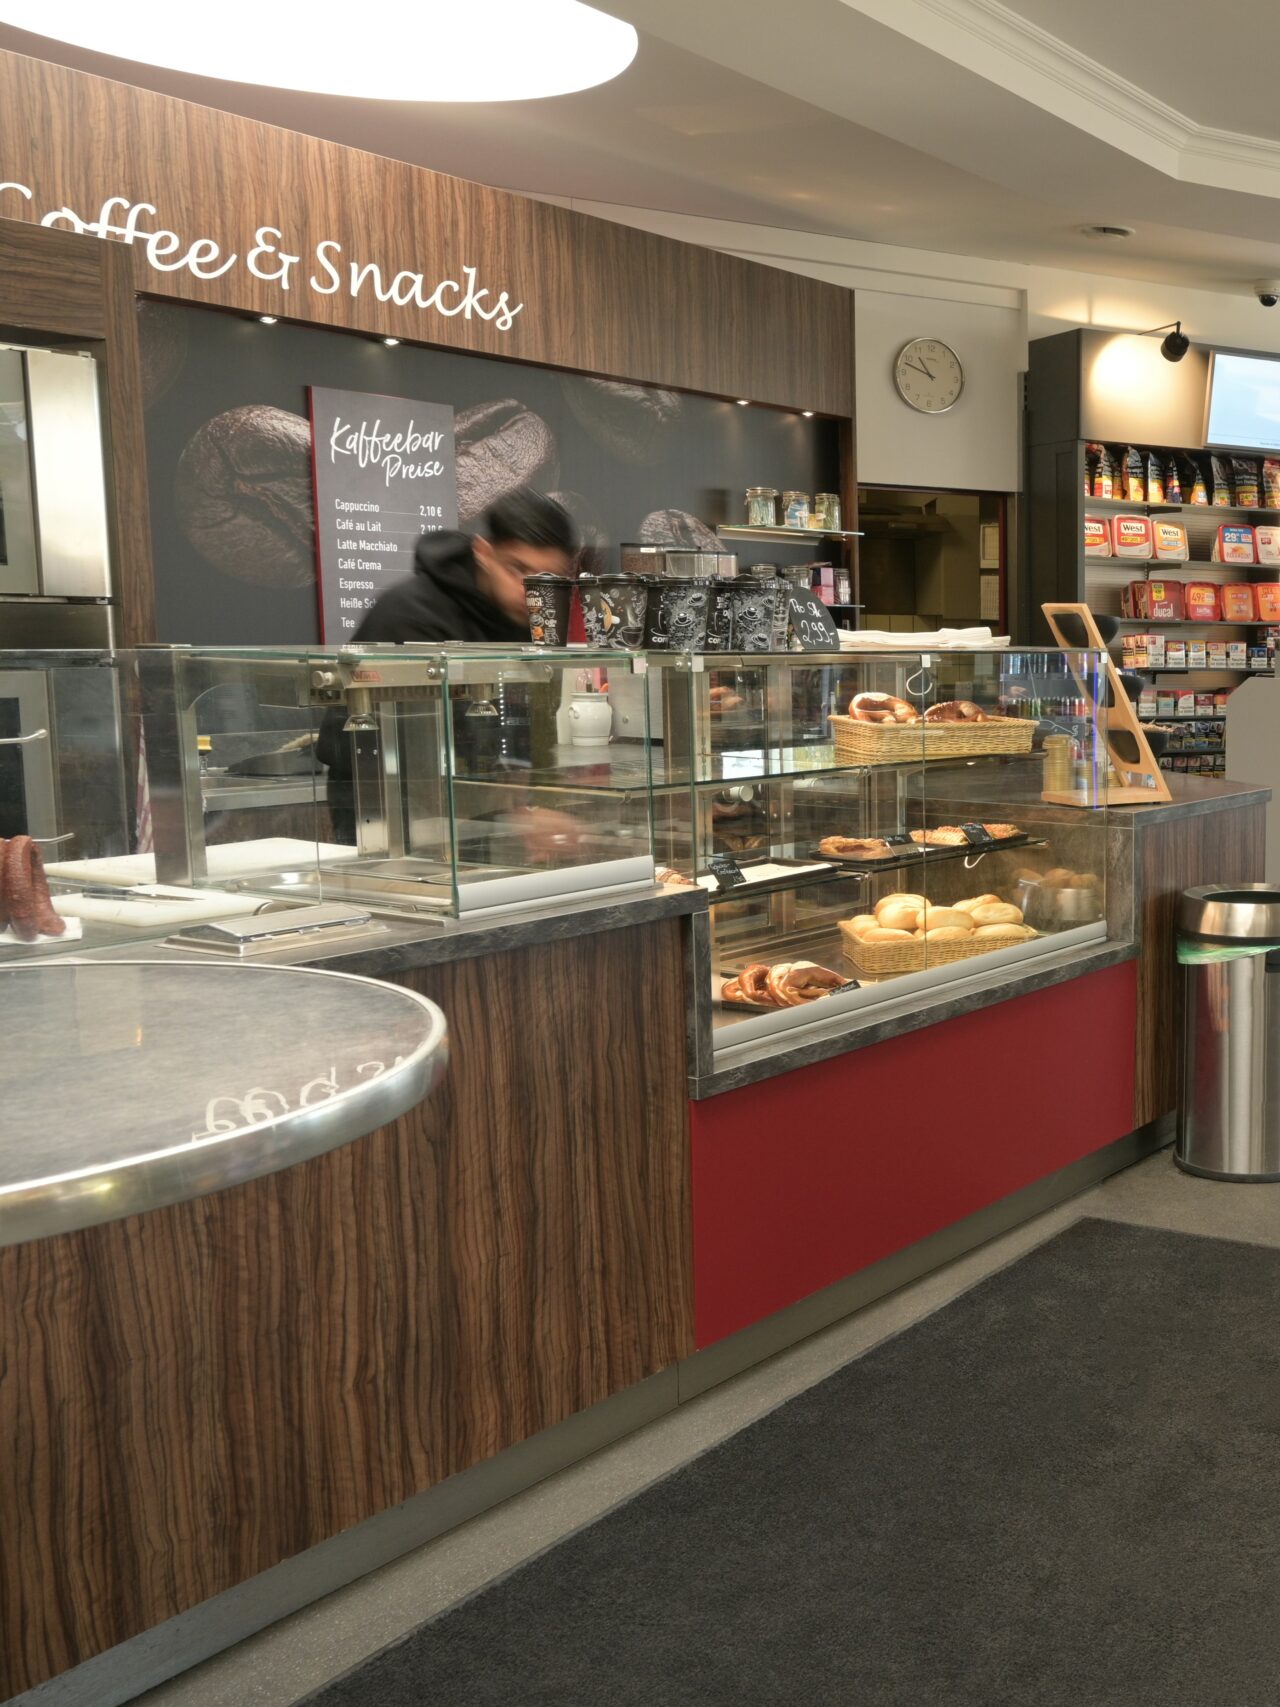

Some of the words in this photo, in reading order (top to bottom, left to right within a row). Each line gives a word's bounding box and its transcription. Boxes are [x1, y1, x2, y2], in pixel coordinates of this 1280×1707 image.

[247, 226, 300, 290] &
[310, 240, 525, 331] Snacks
[330, 416, 444, 468] Kaffeebar
[381, 453, 444, 487] Preise
[335, 498, 380, 513] Cappuccino
[420, 505, 436, 517] 2,10
[436, 507, 443, 517] €
[336, 518, 354, 531] Café
[355, 522, 365, 531] au
[366, 520, 382, 532] Lait
[1122, 523, 1144, 533] West
[1161, 527, 1180, 537] West
[337, 538, 358, 550] Latte
[359, 539, 398, 552] Macchiato
[338, 558, 356, 570] Café
[357, 559, 382, 571] Crema
[339, 578, 374, 591] Espresso
[340, 598, 363, 609] Heiße
[1153, 604, 1174, 618] ducal
[341, 617, 355, 628] Tee
